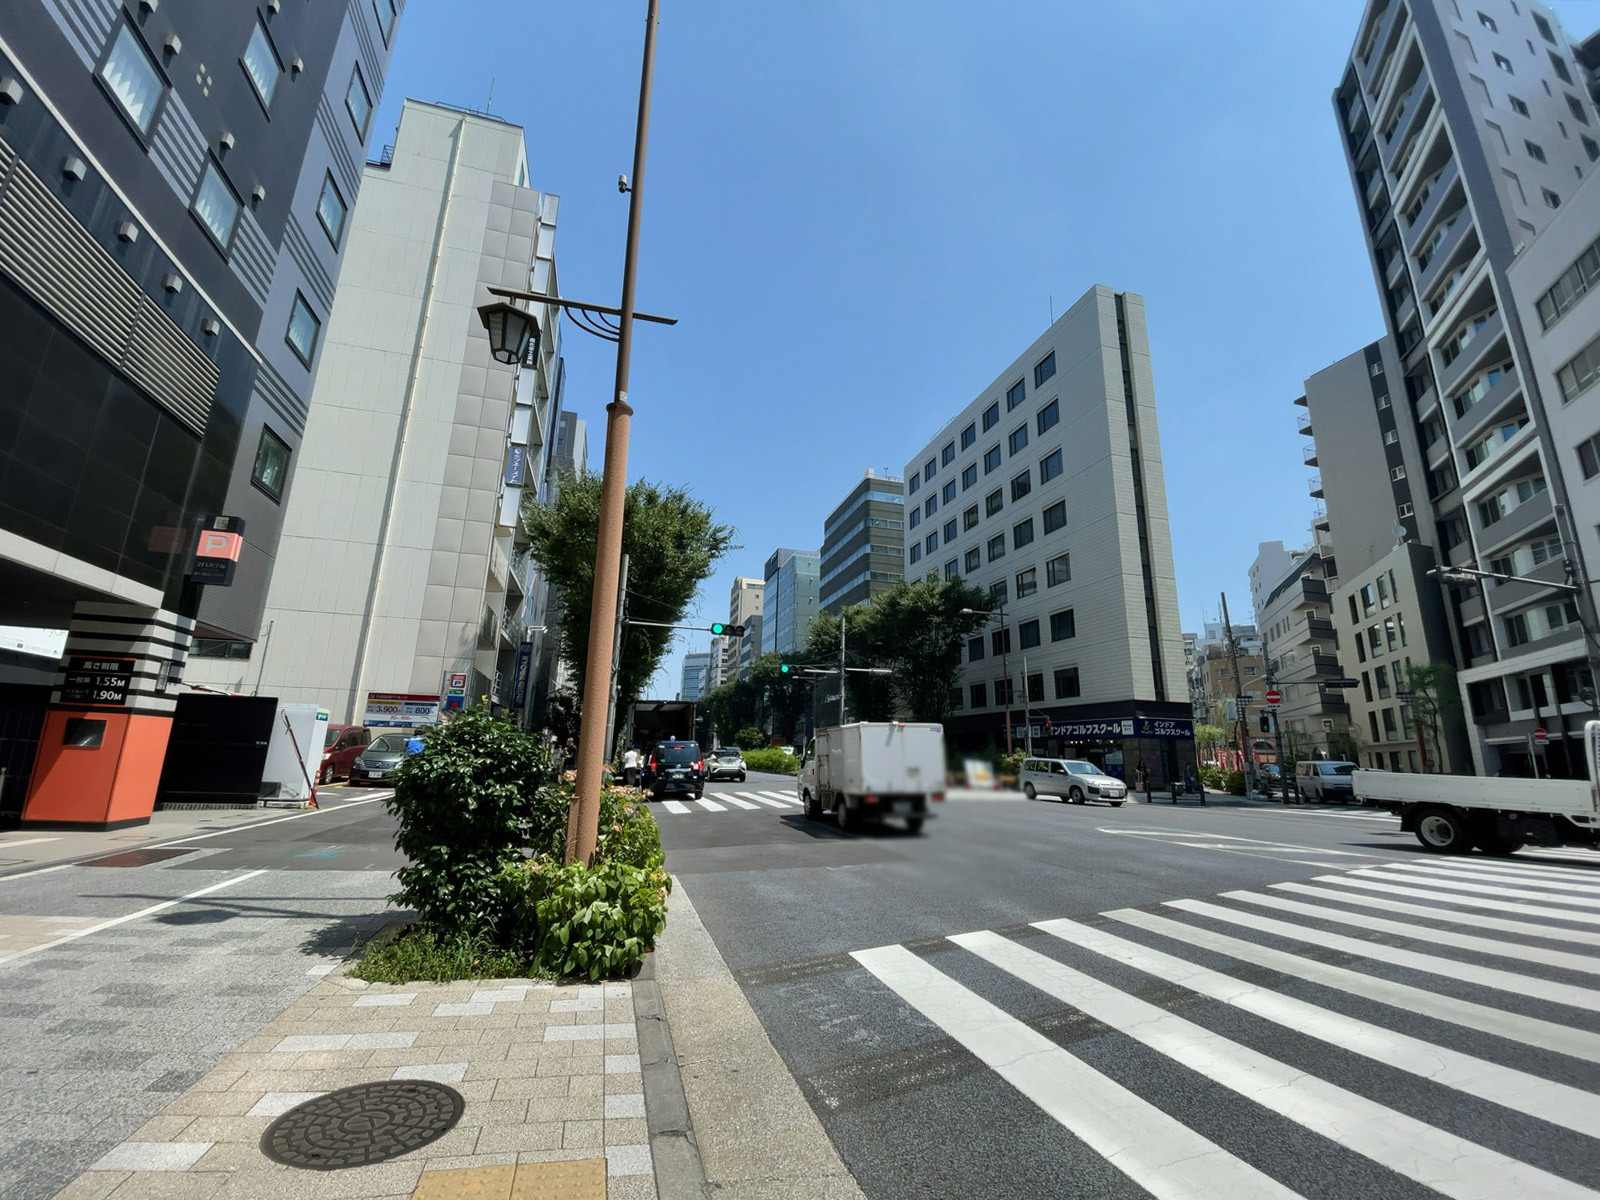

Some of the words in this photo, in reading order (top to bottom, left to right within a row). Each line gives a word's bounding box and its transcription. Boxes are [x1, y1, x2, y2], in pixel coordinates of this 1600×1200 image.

[205, 535, 228, 553] P
[96, 676, 125, 687] 1.55M
[93, 690, 122, 700] 1.90M
[1154, 728, 1191, 736] ゴルフスクール
